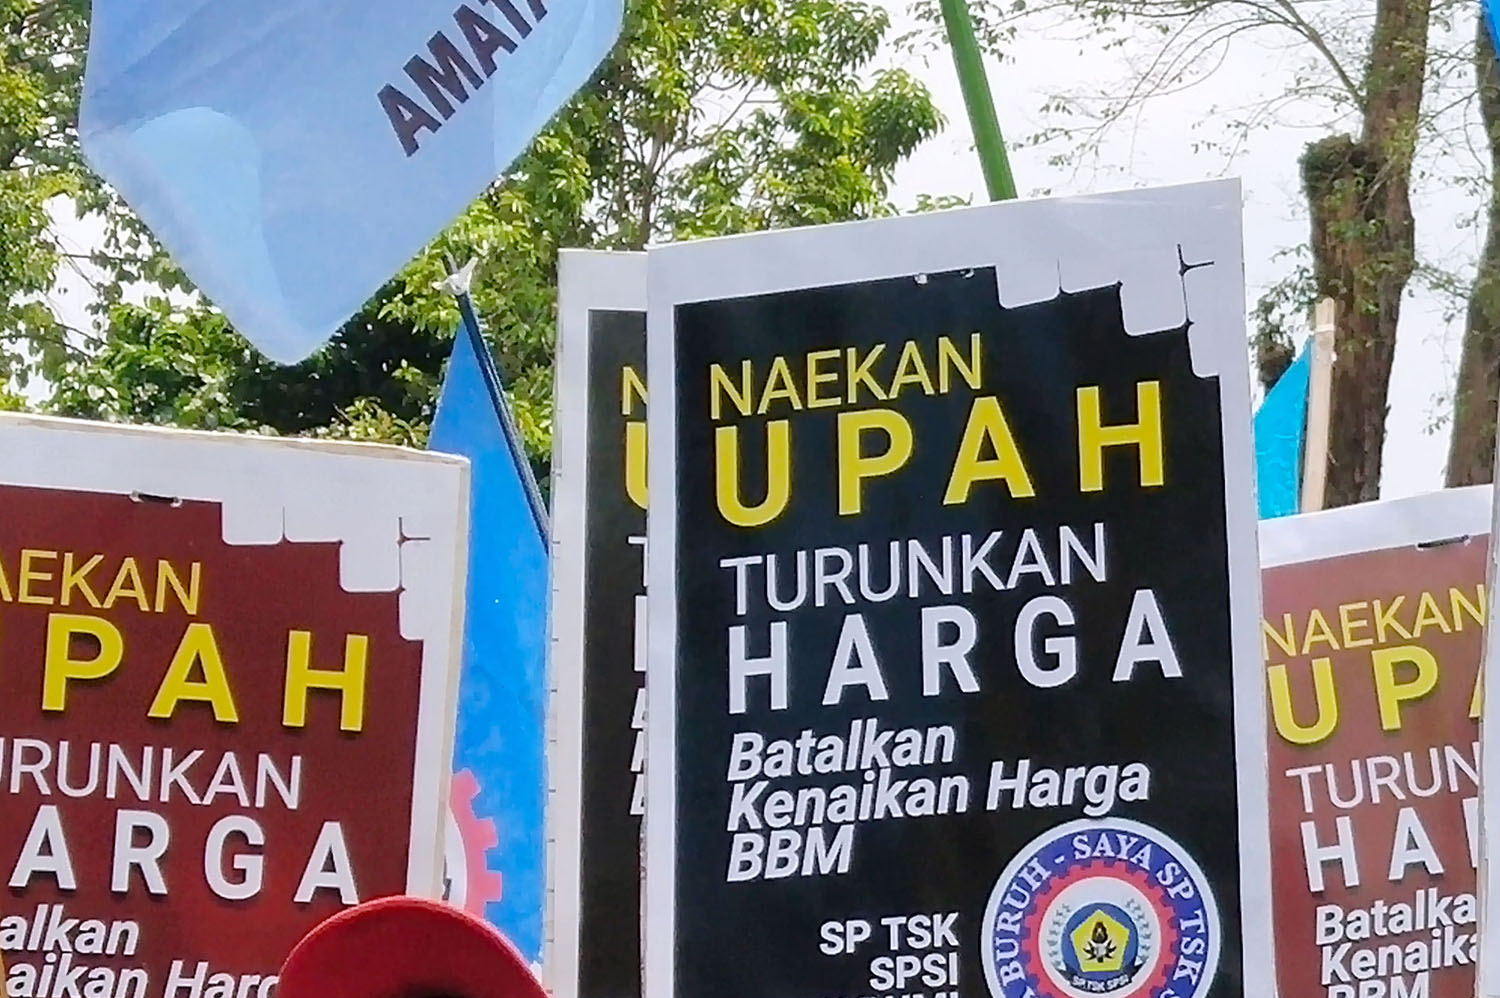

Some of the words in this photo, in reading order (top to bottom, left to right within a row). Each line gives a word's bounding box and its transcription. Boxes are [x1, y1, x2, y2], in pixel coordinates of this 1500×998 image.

[377, 0, 548, 157] AMAT
[709, 332, 983, 420] NAEKAN
[714, 380, 1165, 528] UPAH
[0, 549, 201, 615] EKAN
[719, 523, 1106, 616] TURUNKAN
[728, 589, 1183, 715] HARGA
[1261, 584, 1487, 660] NAEKAN
[42, 613, 368, 732] PAH
[1267, 645, 1482, 744] UP
[0, 738, 301, 809] RUNKAN
[727, 718, 955, 782] Batalkan
[1286, 741, 1481, 813] TURUN
[726, 768, 969, 832] Kenaikan
[986, 759, 1151, 816] Harga
[9, 805, 359, 905] ARGA
[726, 825, 855, 882] BBM
[1072, 832, 1151, 870] SAYA
[1156, 862, 1195, 900] SP
[0, 904, 140, 955] alkan
[819, 919, 871, 955] SP
[881, 911, 960, 951] TSK
[993, 857, 1052, 987] BURUH
[1173, 908, 1206, 985] TSK
[1315, 887, 1476, 946] Batalka
[869, 952, 958, 991] SPSI
[1321, 926, 1476, 985] Kenaik
